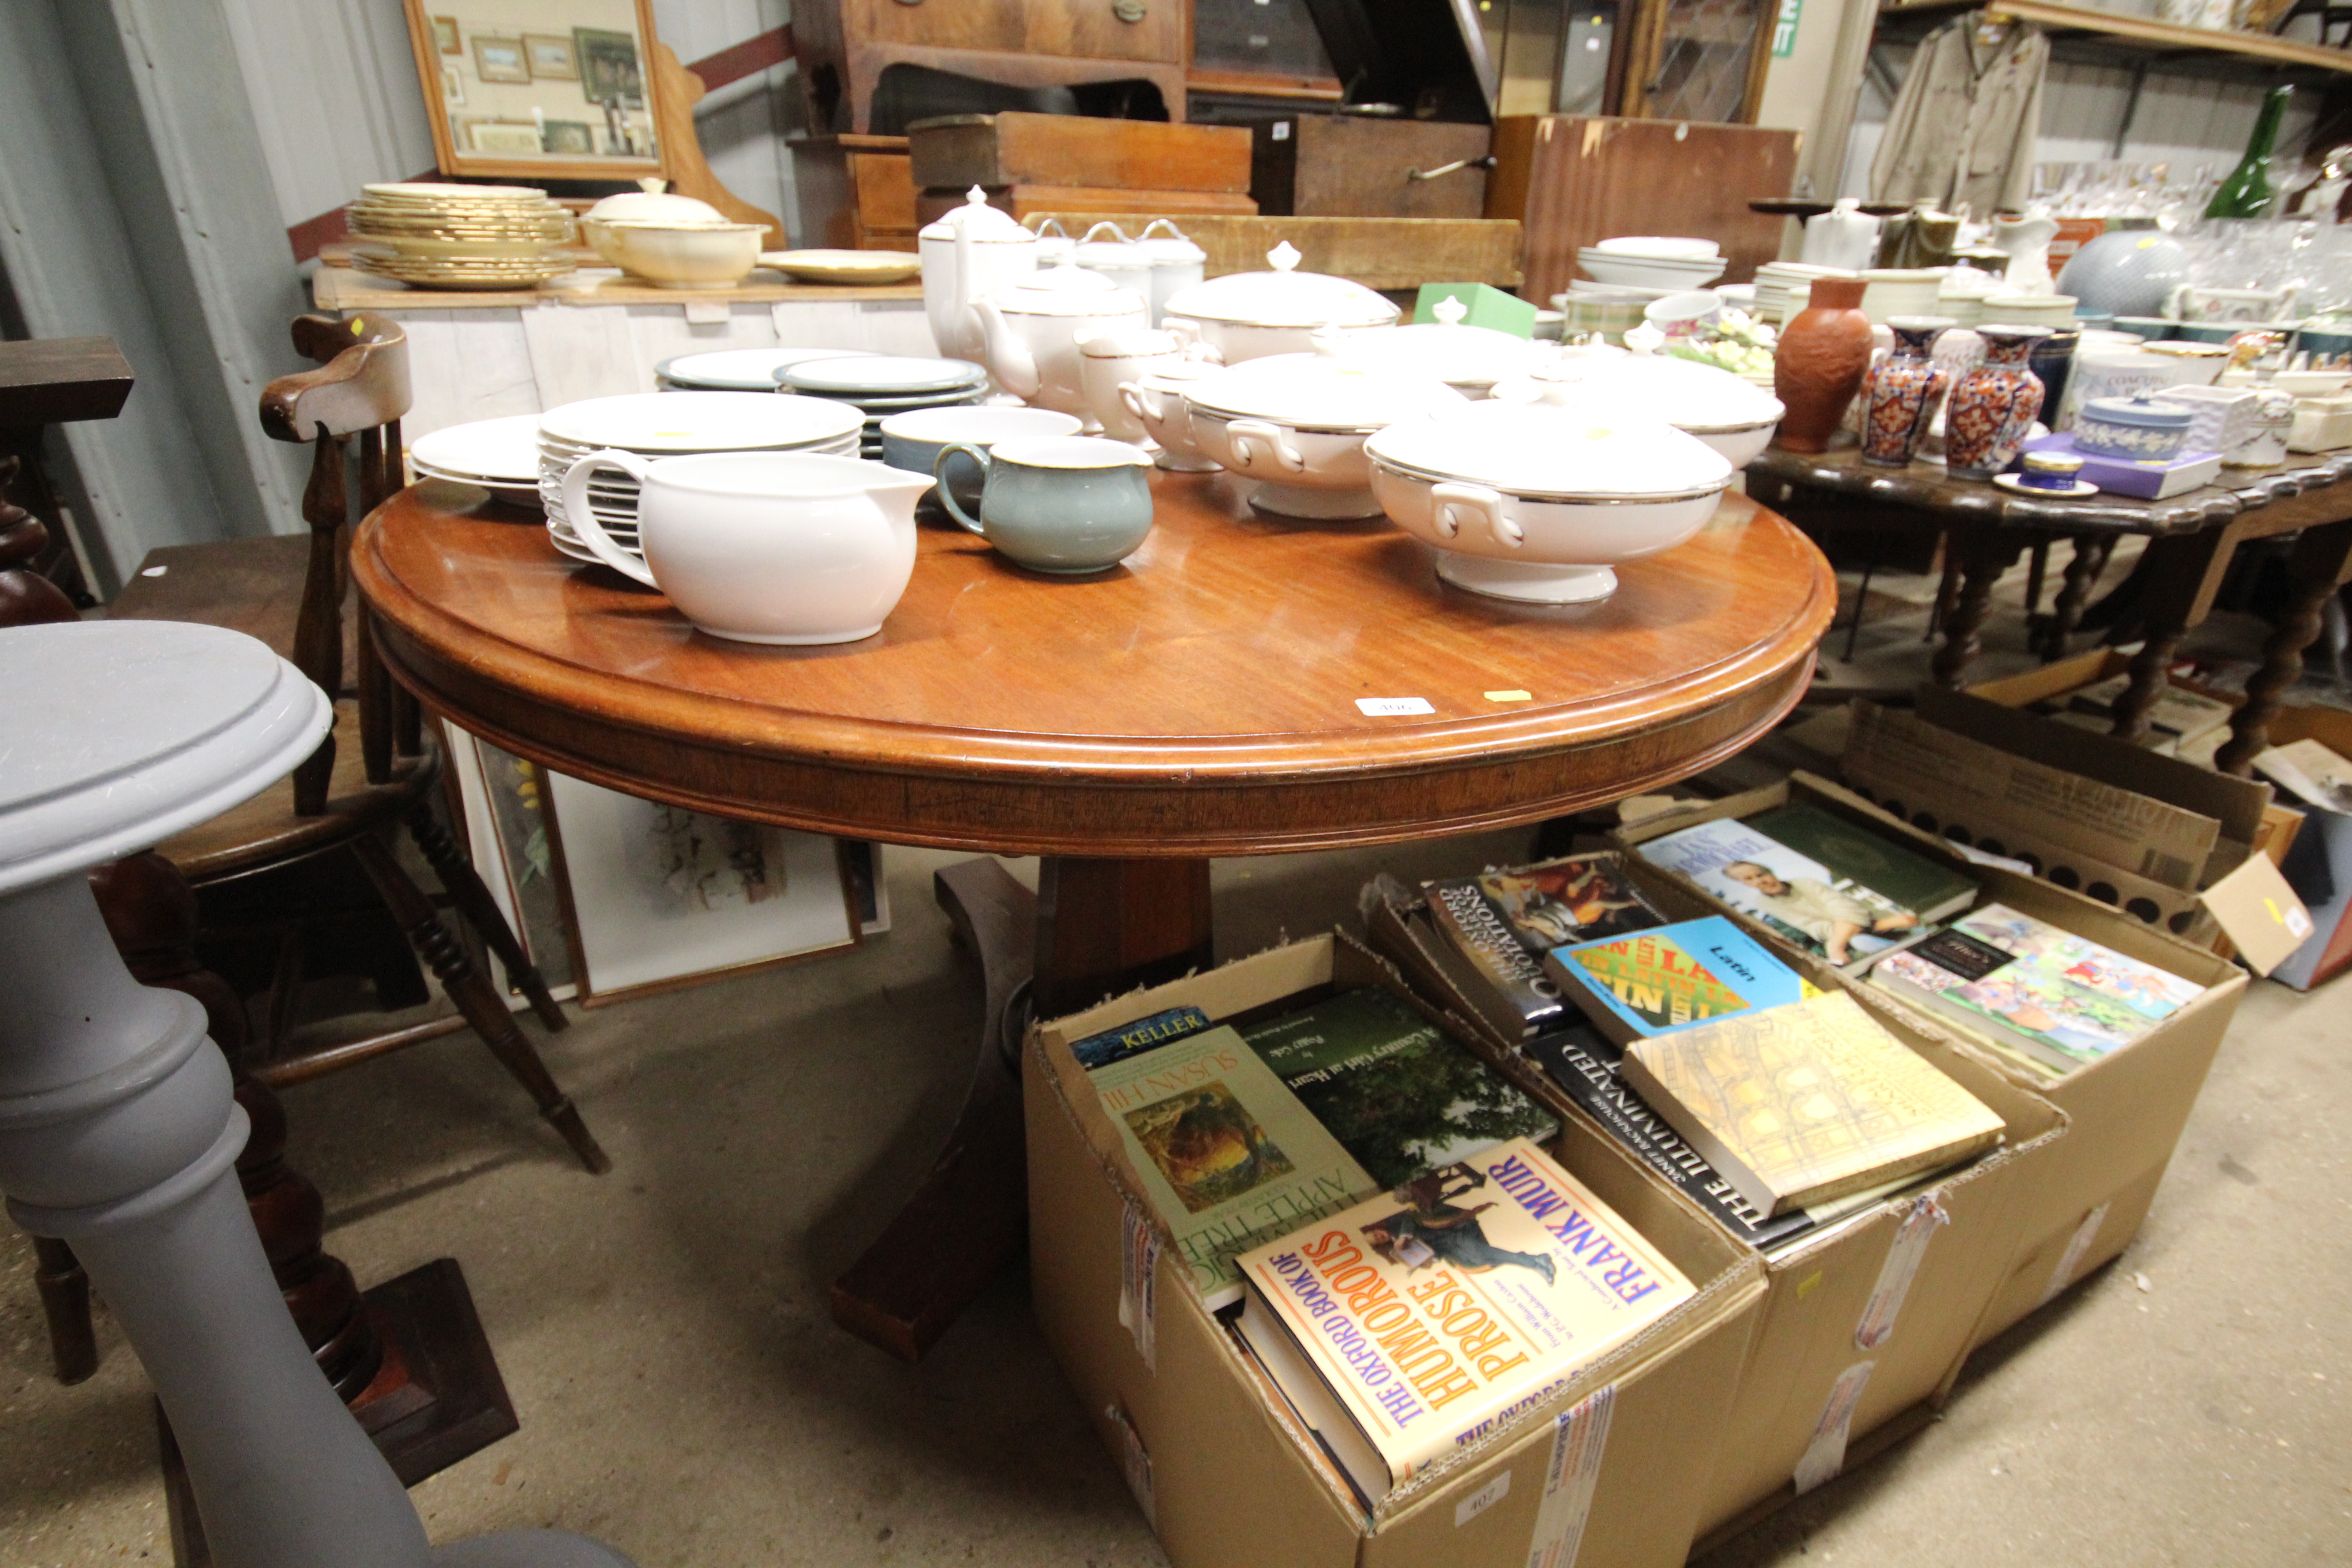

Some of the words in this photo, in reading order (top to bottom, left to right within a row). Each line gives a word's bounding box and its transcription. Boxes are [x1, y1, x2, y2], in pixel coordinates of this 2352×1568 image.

[1439, 888, 1490, 952] OXFORD
[1462, 885, 1562, 999] QUOTATIONS
[1619, 962, 1695, 995] LATIN
[1710, 946, 1756, 982] Latin
[1121, 1014, 1202, 1050] KELLER
[1373, 1032, 1426, 1058] Country
[1146, 1049, 1238, 1093] SUSAN
[1288, 1069, 1331, 1089] Heart
[1562, 1044, 1710, 1177] ILLUMINATED
[1489, 1155, 1570, 1221] MUIR
[1647, 1151, 1686, 1183] JANET
[1254, 1168, 1344, 1223] APPLE
[1704, 1179, 1765, 1231] THE
[1269, 1252, 1303, 1275] OF
[1545, 1210, 1662, 1306] FRANK
[1285, 1268, 1339, 1318] BOOK
[1301, 1230, 1479, 1411] HUMOROUS
[1406, 1270, 1530, 1382] PROSE
[1323, 1316, 1392, 1387] OXFORD
[1376, 1381, 1424, 1429] THE
[1470, 1488, 1496, 1511] 407
